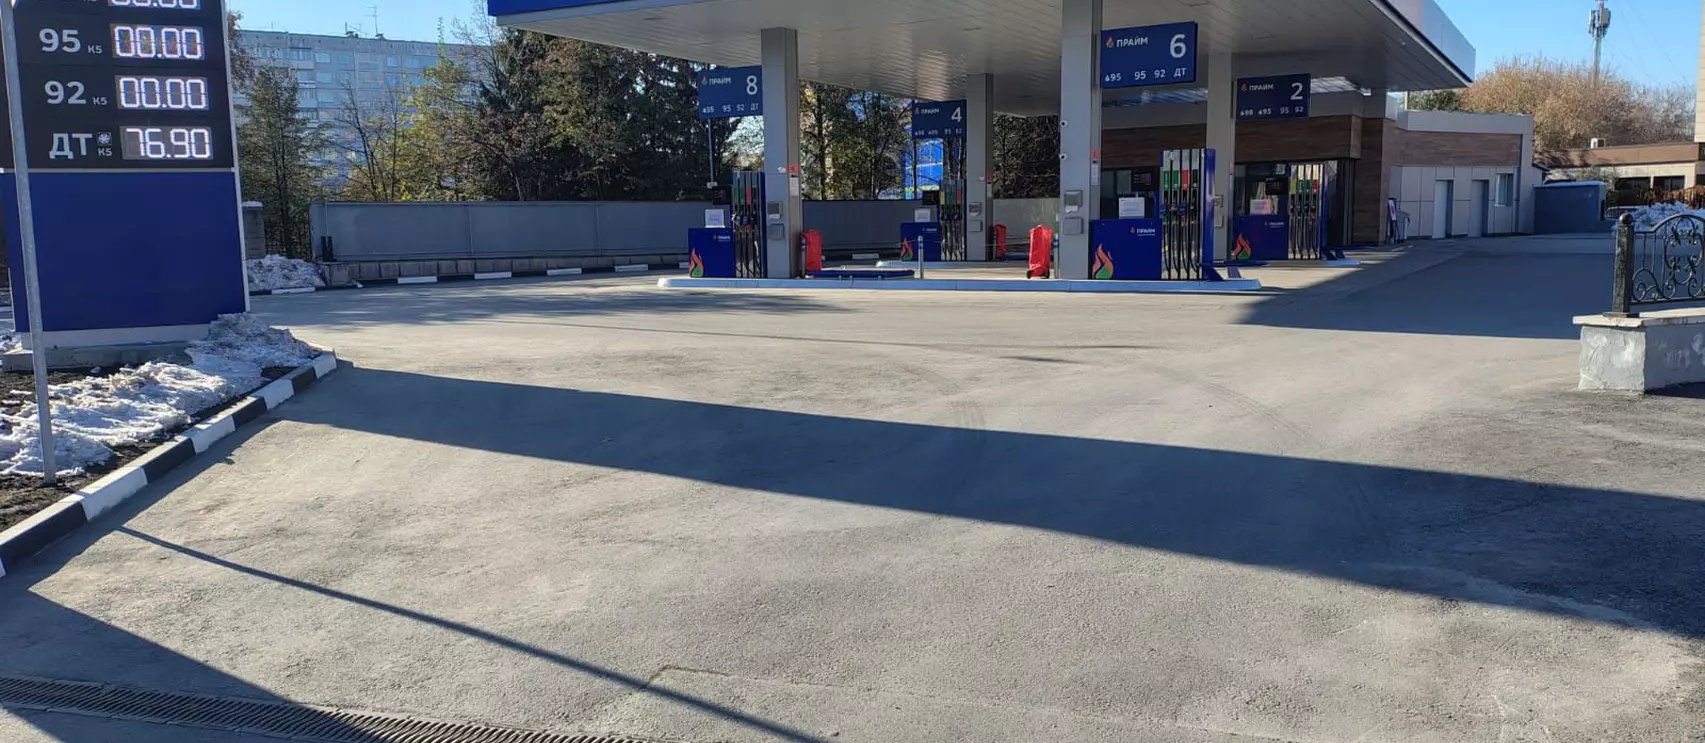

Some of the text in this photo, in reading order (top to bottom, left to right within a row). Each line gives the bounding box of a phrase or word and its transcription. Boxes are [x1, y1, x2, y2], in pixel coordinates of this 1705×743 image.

[38, 28, 81, 53] 95
[114, 26, 203, 59] 00.00
[1116, 35, 1149, 48] ПРАЙМ
[1169, 33, 1186, 59] 6
[708, 76, 732, 86] ПРАЙМ
[1110, 67, 1187, 82] 95 95 92 ДТ
[44, 80, 87, 105] 92
[119, 76, 206, 109] 00.00
[746, 75, 758, 96] 8
[1249, 82, 1275, 91] ПРАЙМ
[1290, 82, 1304, 101] 2
[722, 104, 732, 113] 95
[736, 103, 745, 112] 92
[750, 102, 759, 111] ДТ
[950, 106, 963, 123] 4
[1279, 106, 1290, 115] 95
[48, 132, 93, 160] ДТ
[126, 127, 210, 159] 76.90
